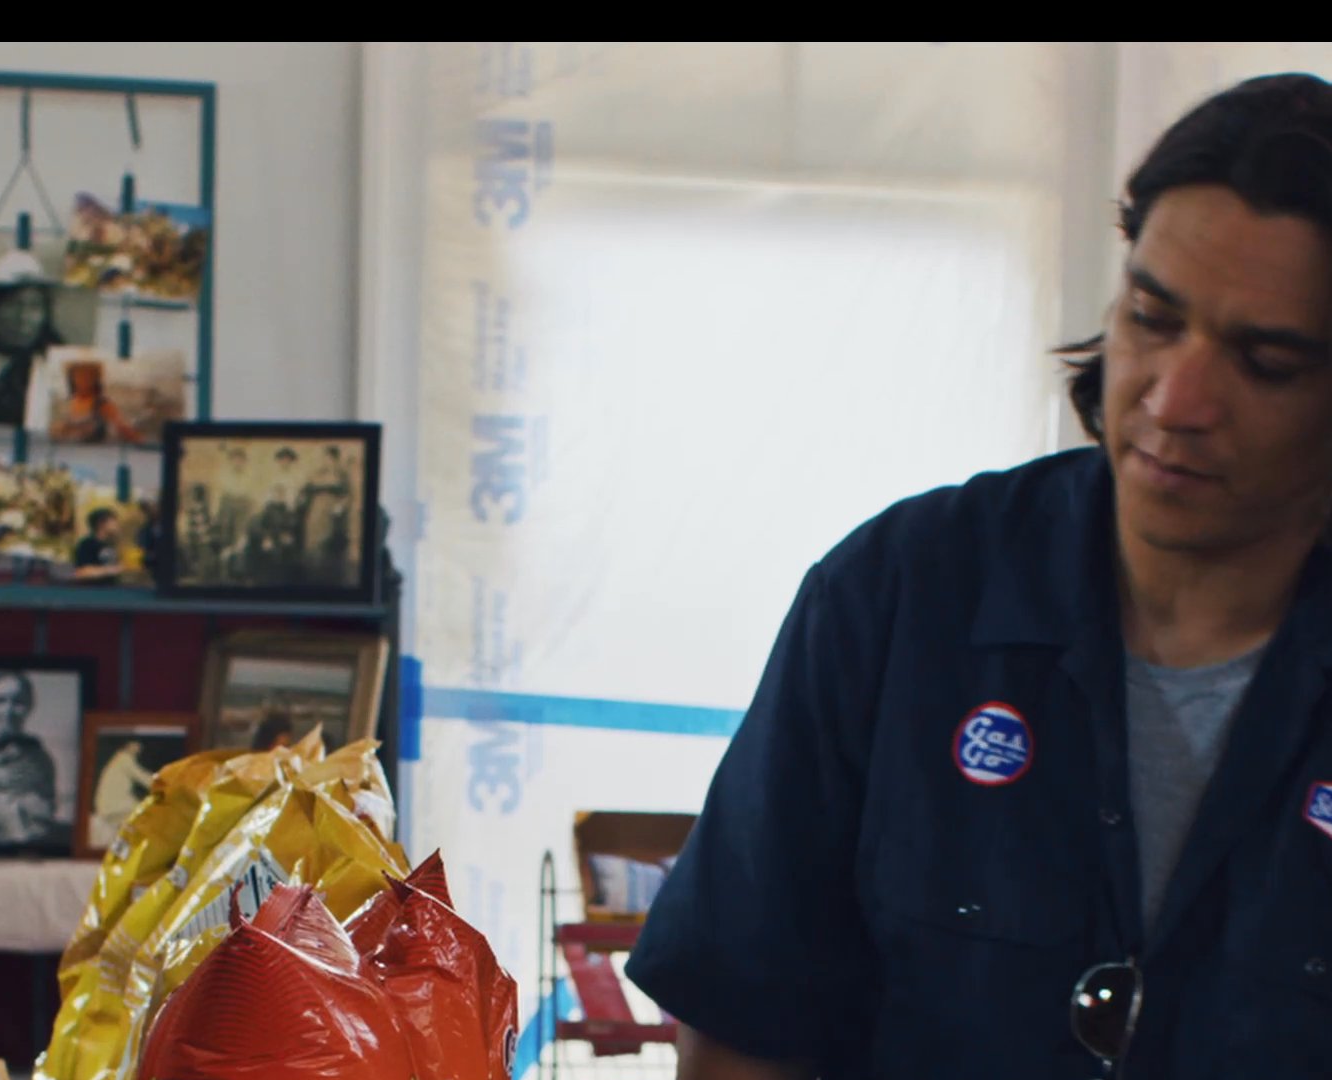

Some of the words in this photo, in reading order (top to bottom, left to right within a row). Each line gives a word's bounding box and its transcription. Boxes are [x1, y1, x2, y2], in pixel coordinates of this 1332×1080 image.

[473, 119, 530, 229] 3M
[471, 413, 526, 526] 3M
[467, 705, 524, 815] 3M
[962, 742, 1014, 768] Go
[965, 716, 1026, 754] Gas
